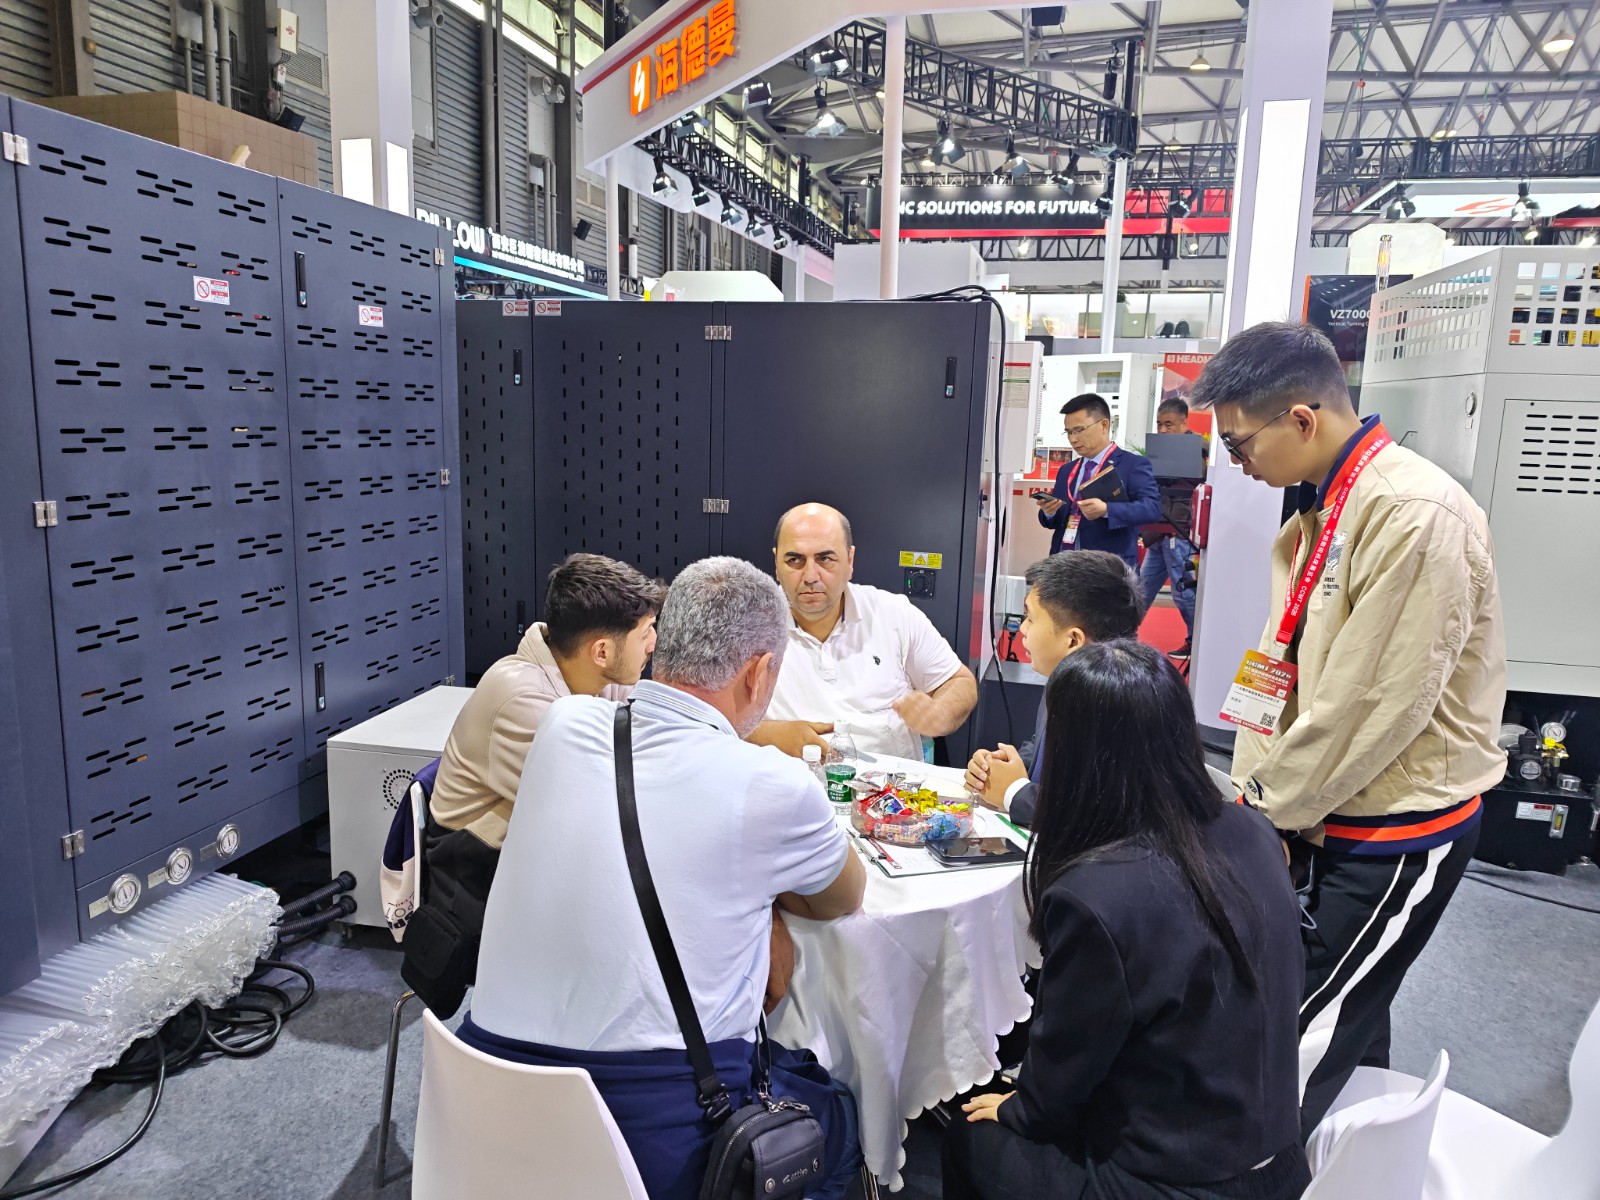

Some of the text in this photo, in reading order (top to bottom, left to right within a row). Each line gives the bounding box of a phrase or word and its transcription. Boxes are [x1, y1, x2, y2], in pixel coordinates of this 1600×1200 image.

[655, 0, 736, 100] 海德曼
[917, 200, 1002, 215] SOLUTIONS
[1005, 200, 1036, 215] FOR
[1039, 200, 1099, 215] FUTURE
[1339, 487, 1349, 504] CCMT
[1296, 585, 1307, 603] CCMT
